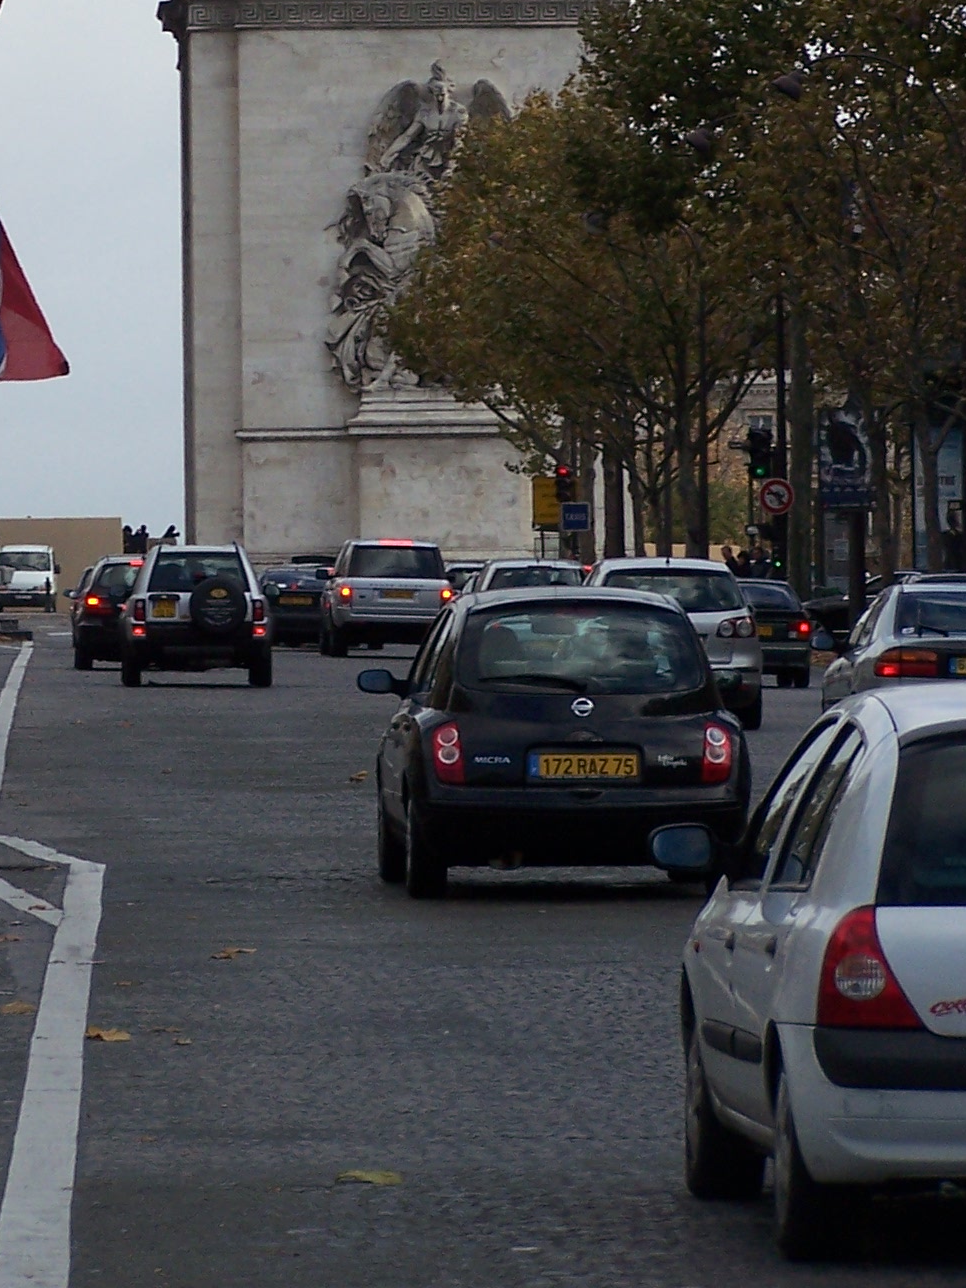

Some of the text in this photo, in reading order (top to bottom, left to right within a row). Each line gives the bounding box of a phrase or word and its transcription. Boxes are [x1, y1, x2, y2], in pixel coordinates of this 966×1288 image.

[474, 756, 511, 764] MICRA
[543, 758, 634, 775] 172 RAZ 75
